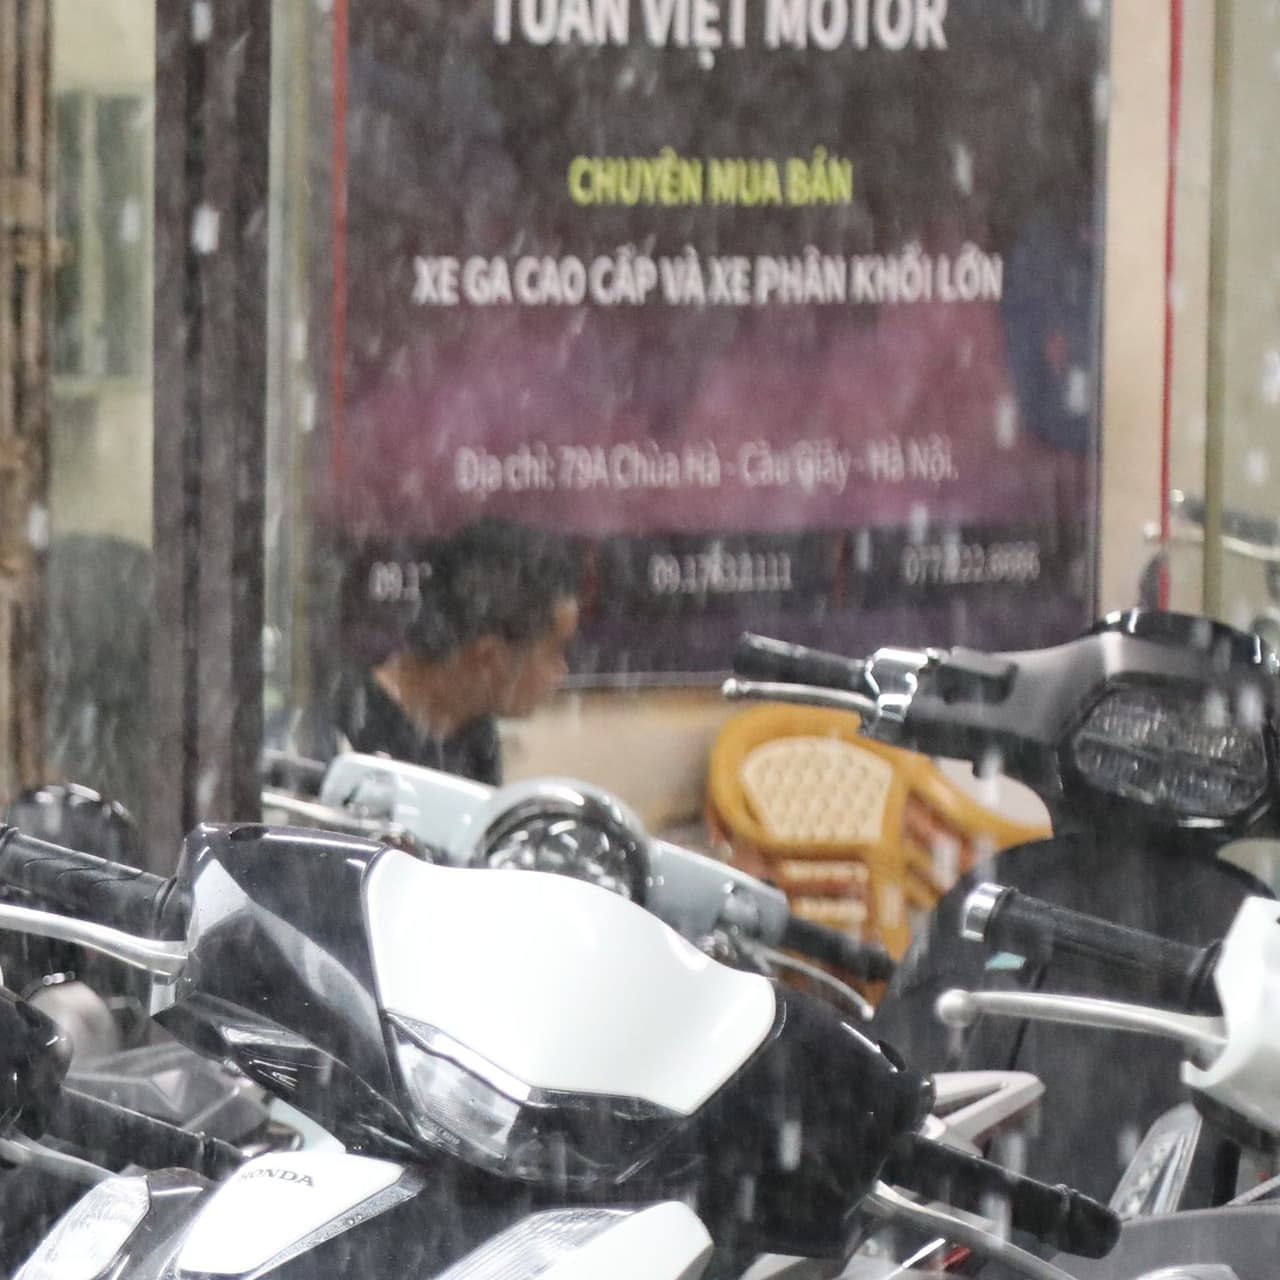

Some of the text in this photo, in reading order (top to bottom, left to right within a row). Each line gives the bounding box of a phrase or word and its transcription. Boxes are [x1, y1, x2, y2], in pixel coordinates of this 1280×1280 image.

[762, 0, 948, 50] MOTOR
[568, 144, 853, 205] CHUYÊN MUA BÁN
[412, 236, 1004, 306] XE GA CAO CẤP VÀ XE PHÂN KHỐI LỚN
